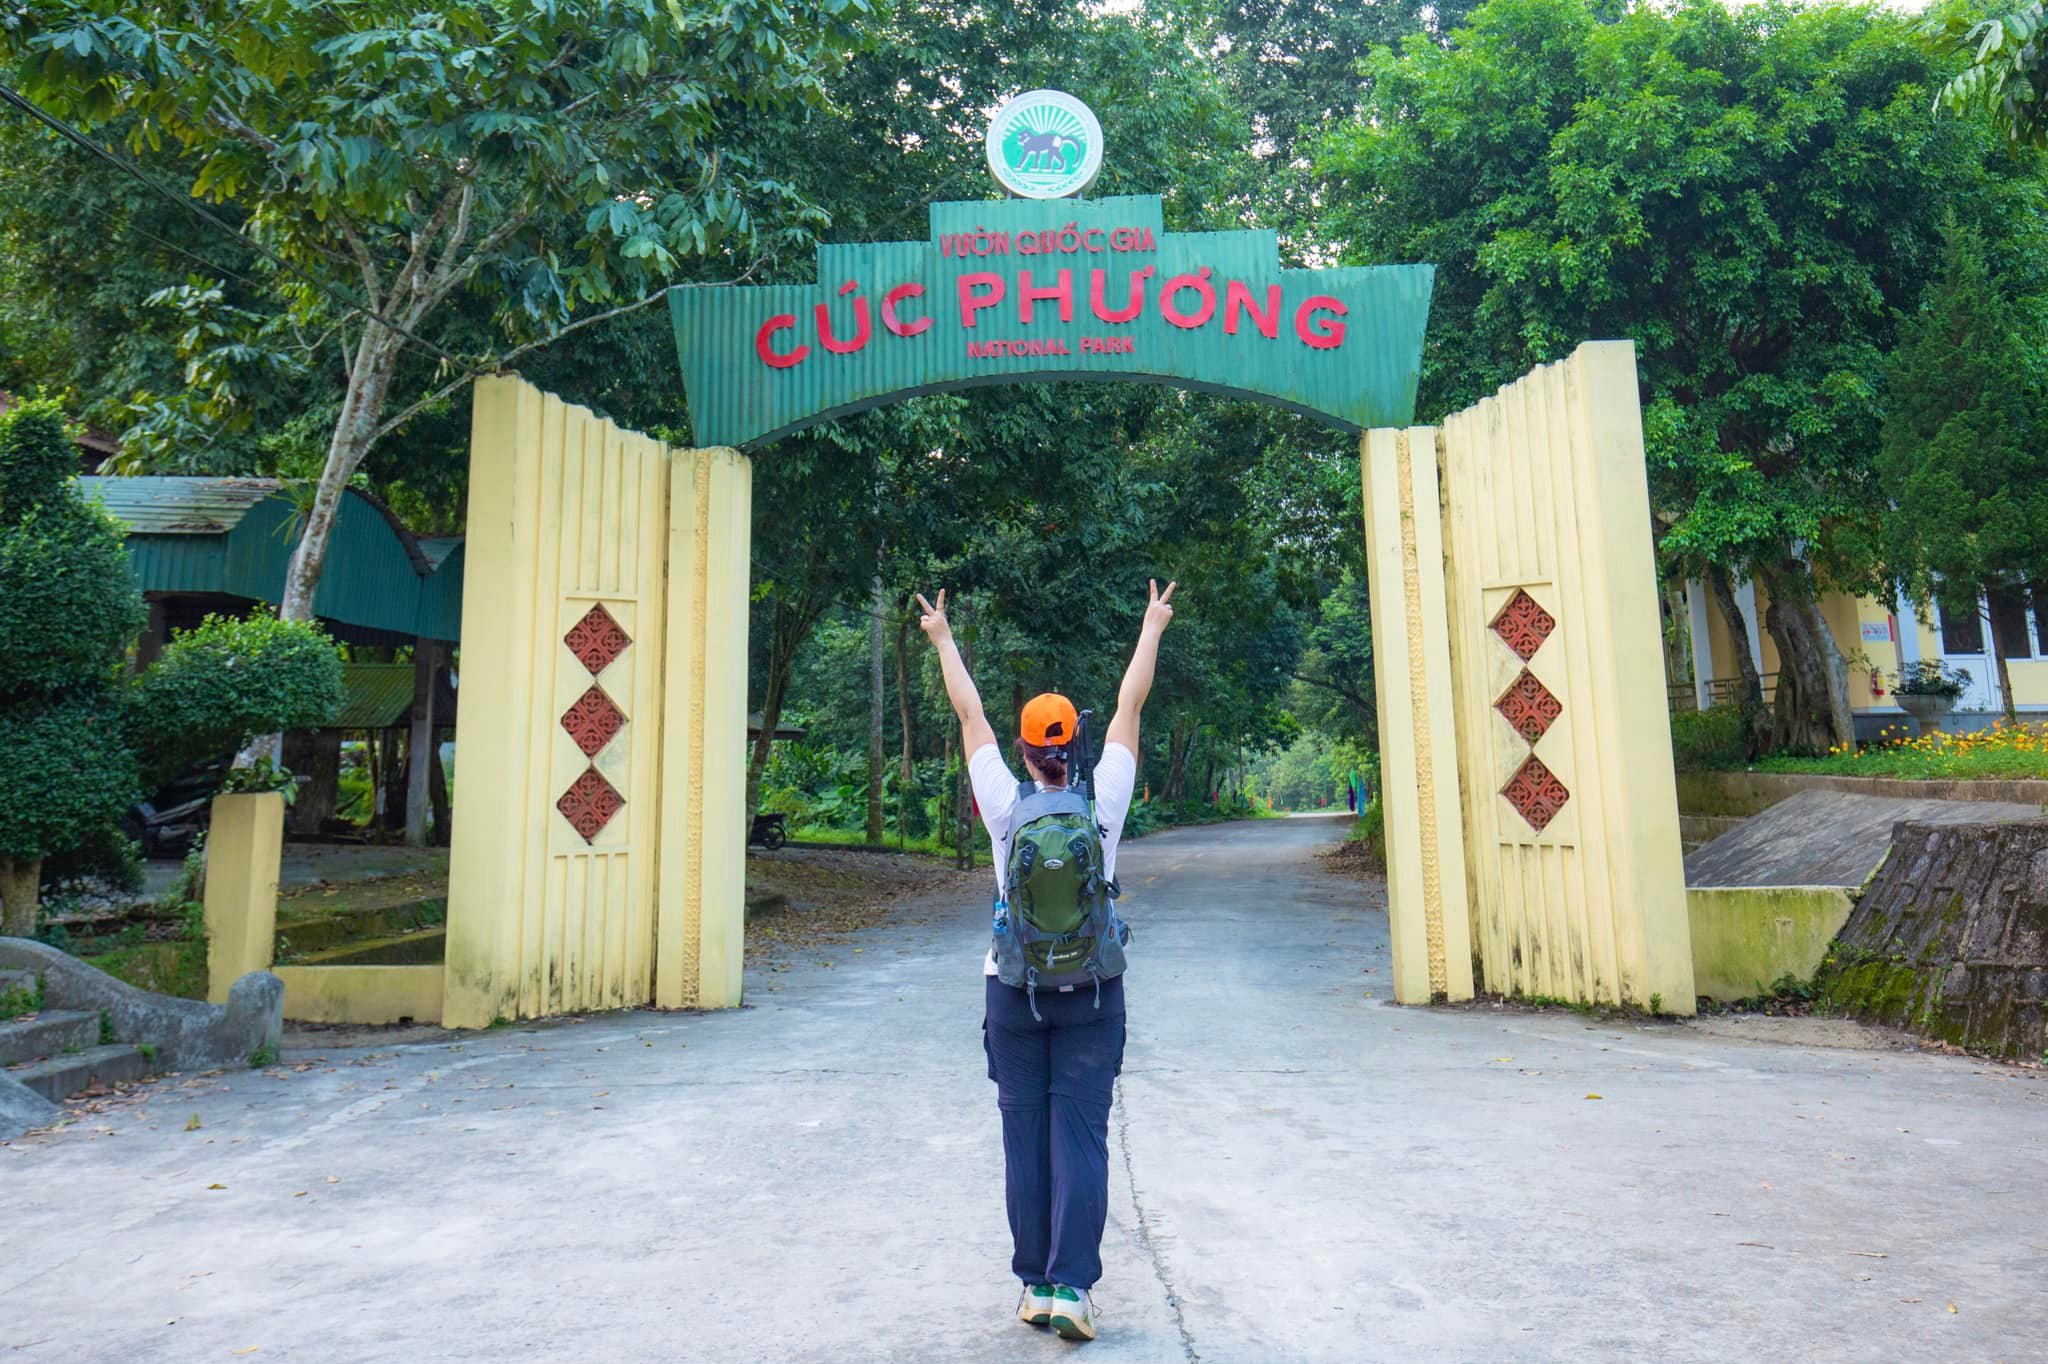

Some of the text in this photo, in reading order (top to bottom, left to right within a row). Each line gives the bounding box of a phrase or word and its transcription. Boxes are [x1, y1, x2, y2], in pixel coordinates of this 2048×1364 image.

[1015, 221, 1103, 254] QUỐC
[1110, 227, 1155, 251] GIA
[756, 265, 1348, 368] CÚC PHƯƠNG
[967, 335, 1135, 357] NATIONAL PARK
